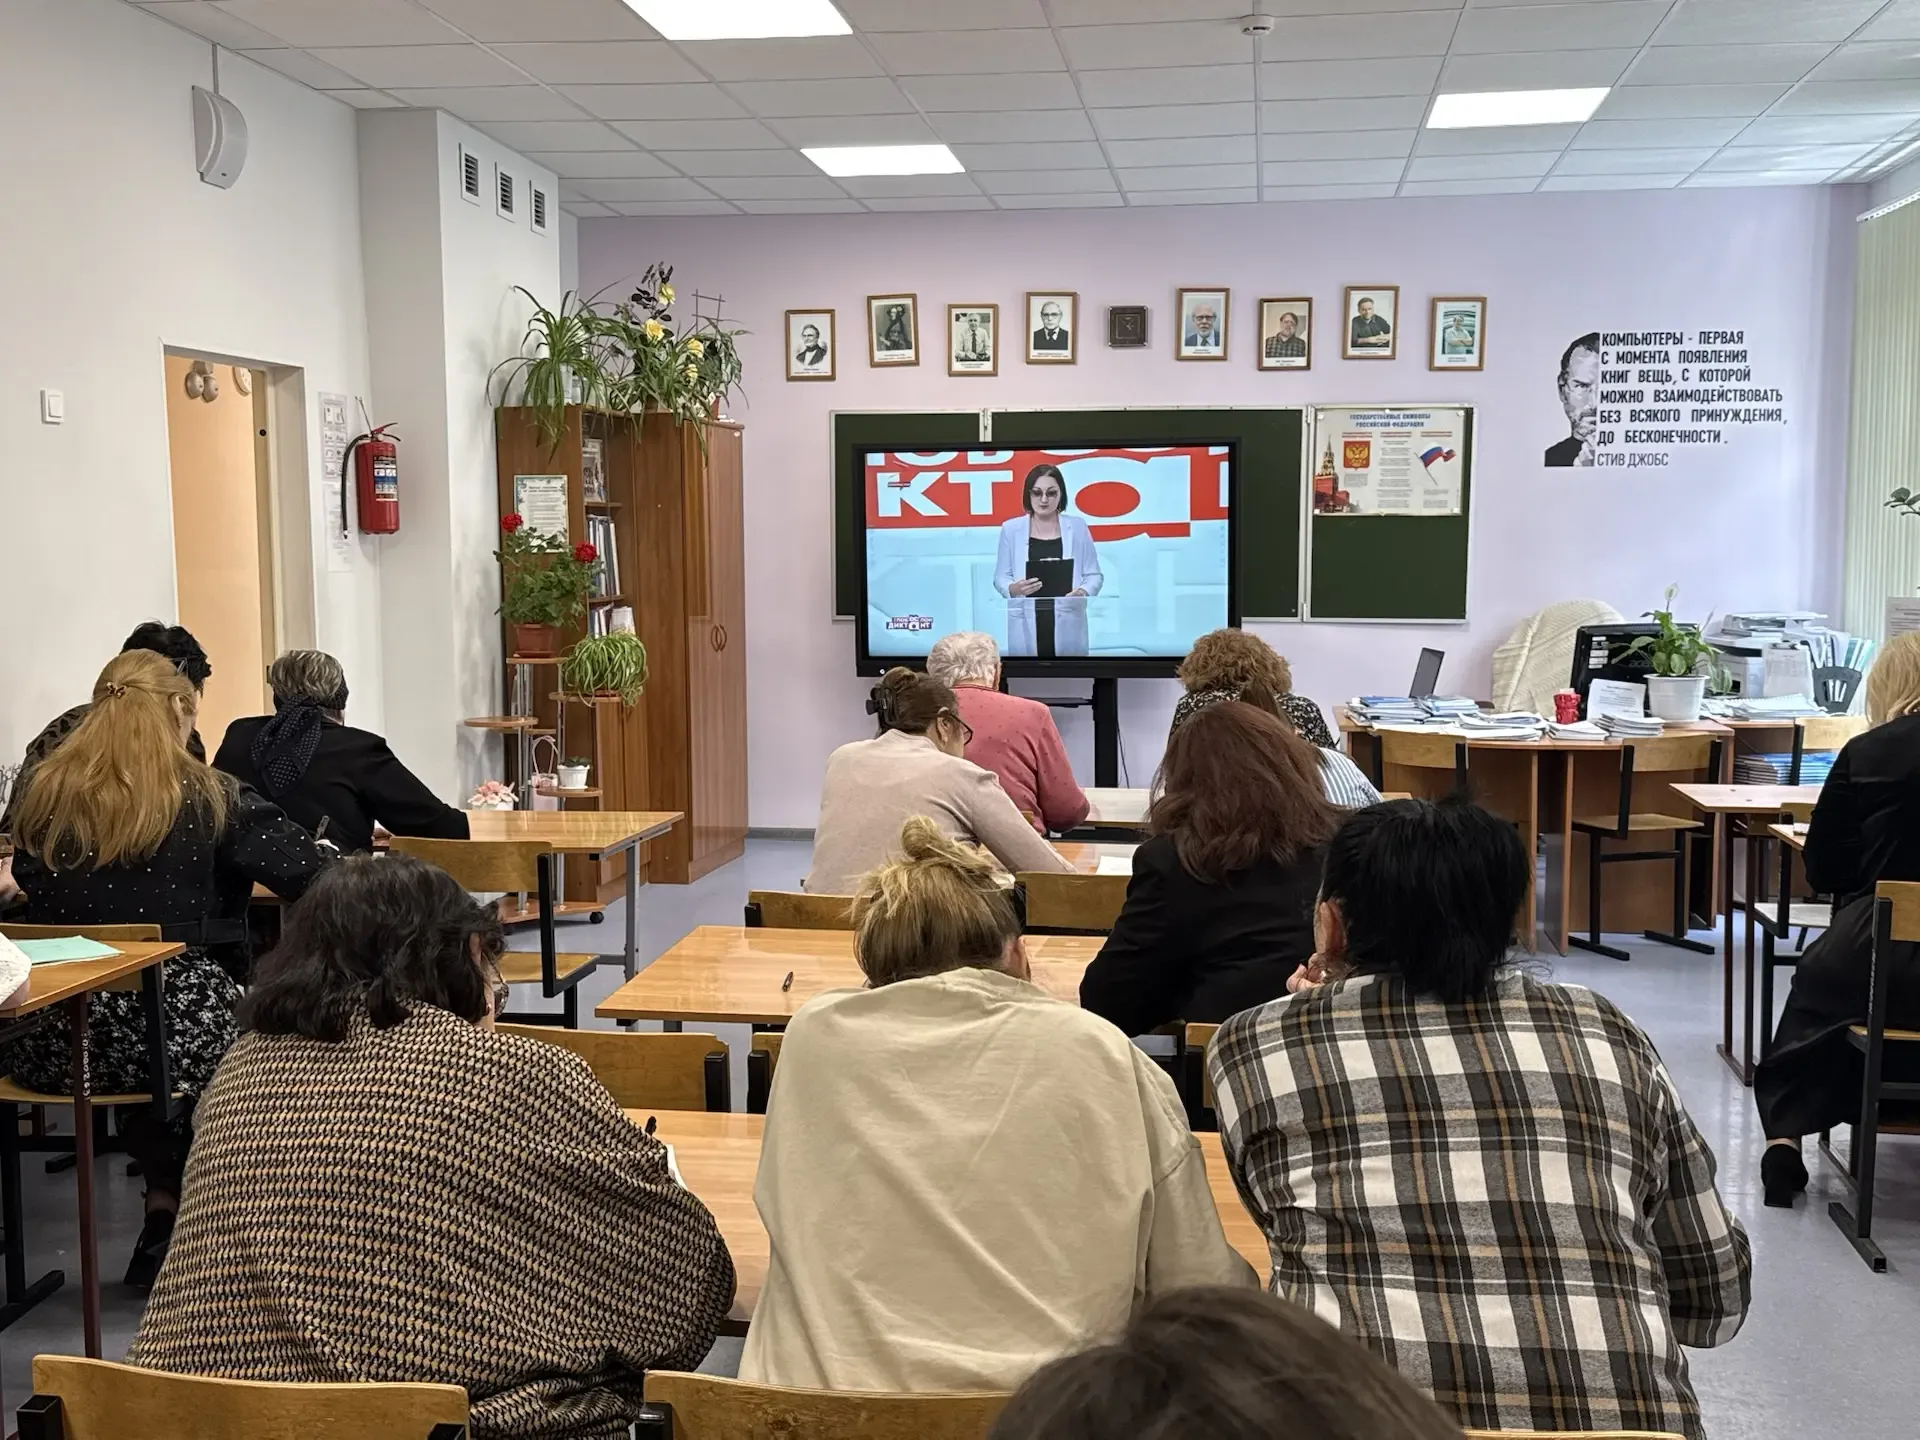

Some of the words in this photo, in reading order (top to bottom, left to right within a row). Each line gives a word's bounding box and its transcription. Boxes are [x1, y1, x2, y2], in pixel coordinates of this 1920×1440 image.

[1602, 332, 1683, 346] КОМПЬЮТЕРЫ
[1699, 330, 1744, 345] ПЕРВАЯ
[1601, 351, 1609, 365] С
[1616, 350, 1670, 364] МОМЕНТА
[1678, 349, 1747, 364] ПОЯВЛЕНИЯ
[1601, 369, 1631, 384] КНИГ
[1638, 369, 1677, 385] ВЕЩЬ,
[1681, 368, 1690, 382] С
[1699, 365, 1751, 382] КОТОРОЙ
[1600, 390, 1644, 404] МОЖНО
[1653, 385, 1783, 405] ВЗАИМОДЕЙСТВОВАТЬ
[1600, 410, 1621, 424] БЕЗ
[1630, 408, 1680, 423] ВСЯКОГО
[1691, 408, 1787, 425] ПРИНУЖДЕНИЯ,
[1597, 431, 1615, 447] ДО
[1625, 429, 1728, 444] БЕСКОНЕЧНОСТИ.
[1597, 452, 1626, 467] СТИВ
[1627, 452, 1669, 468] ДЖОБС
